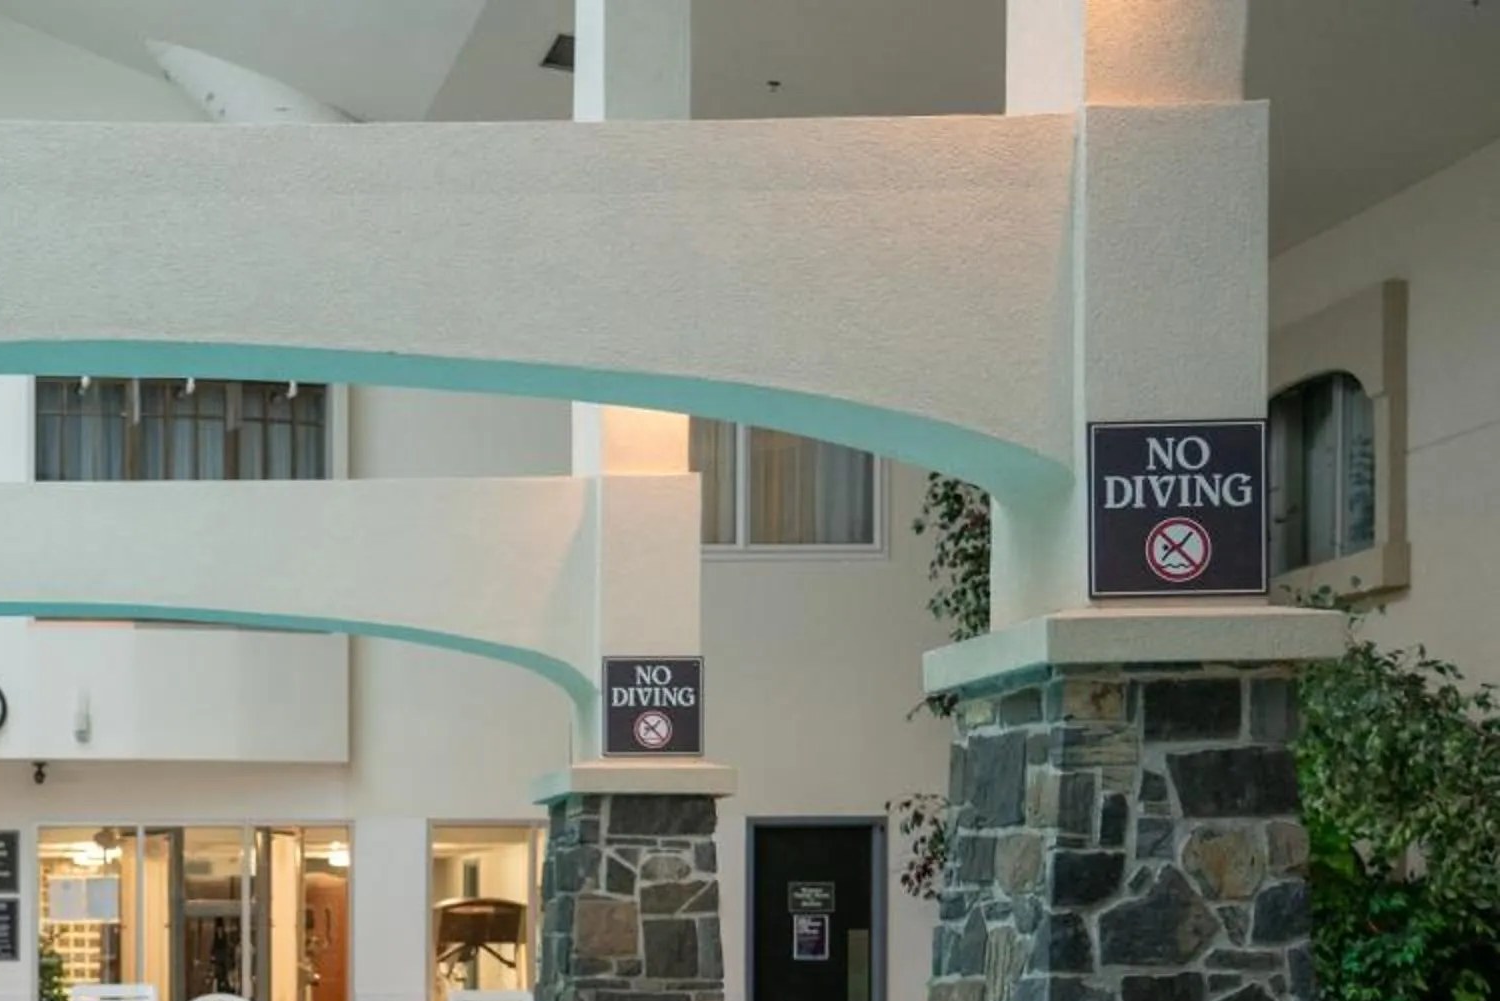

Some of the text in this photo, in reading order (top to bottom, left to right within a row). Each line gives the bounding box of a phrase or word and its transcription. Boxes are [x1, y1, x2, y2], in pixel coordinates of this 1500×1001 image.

[1146, 435, 1211, 471] NO
[1104, 473, 1253, 509] DIVING
[634, 665, 672, 686] NO
[612, 687, 695, 707] DIVING
